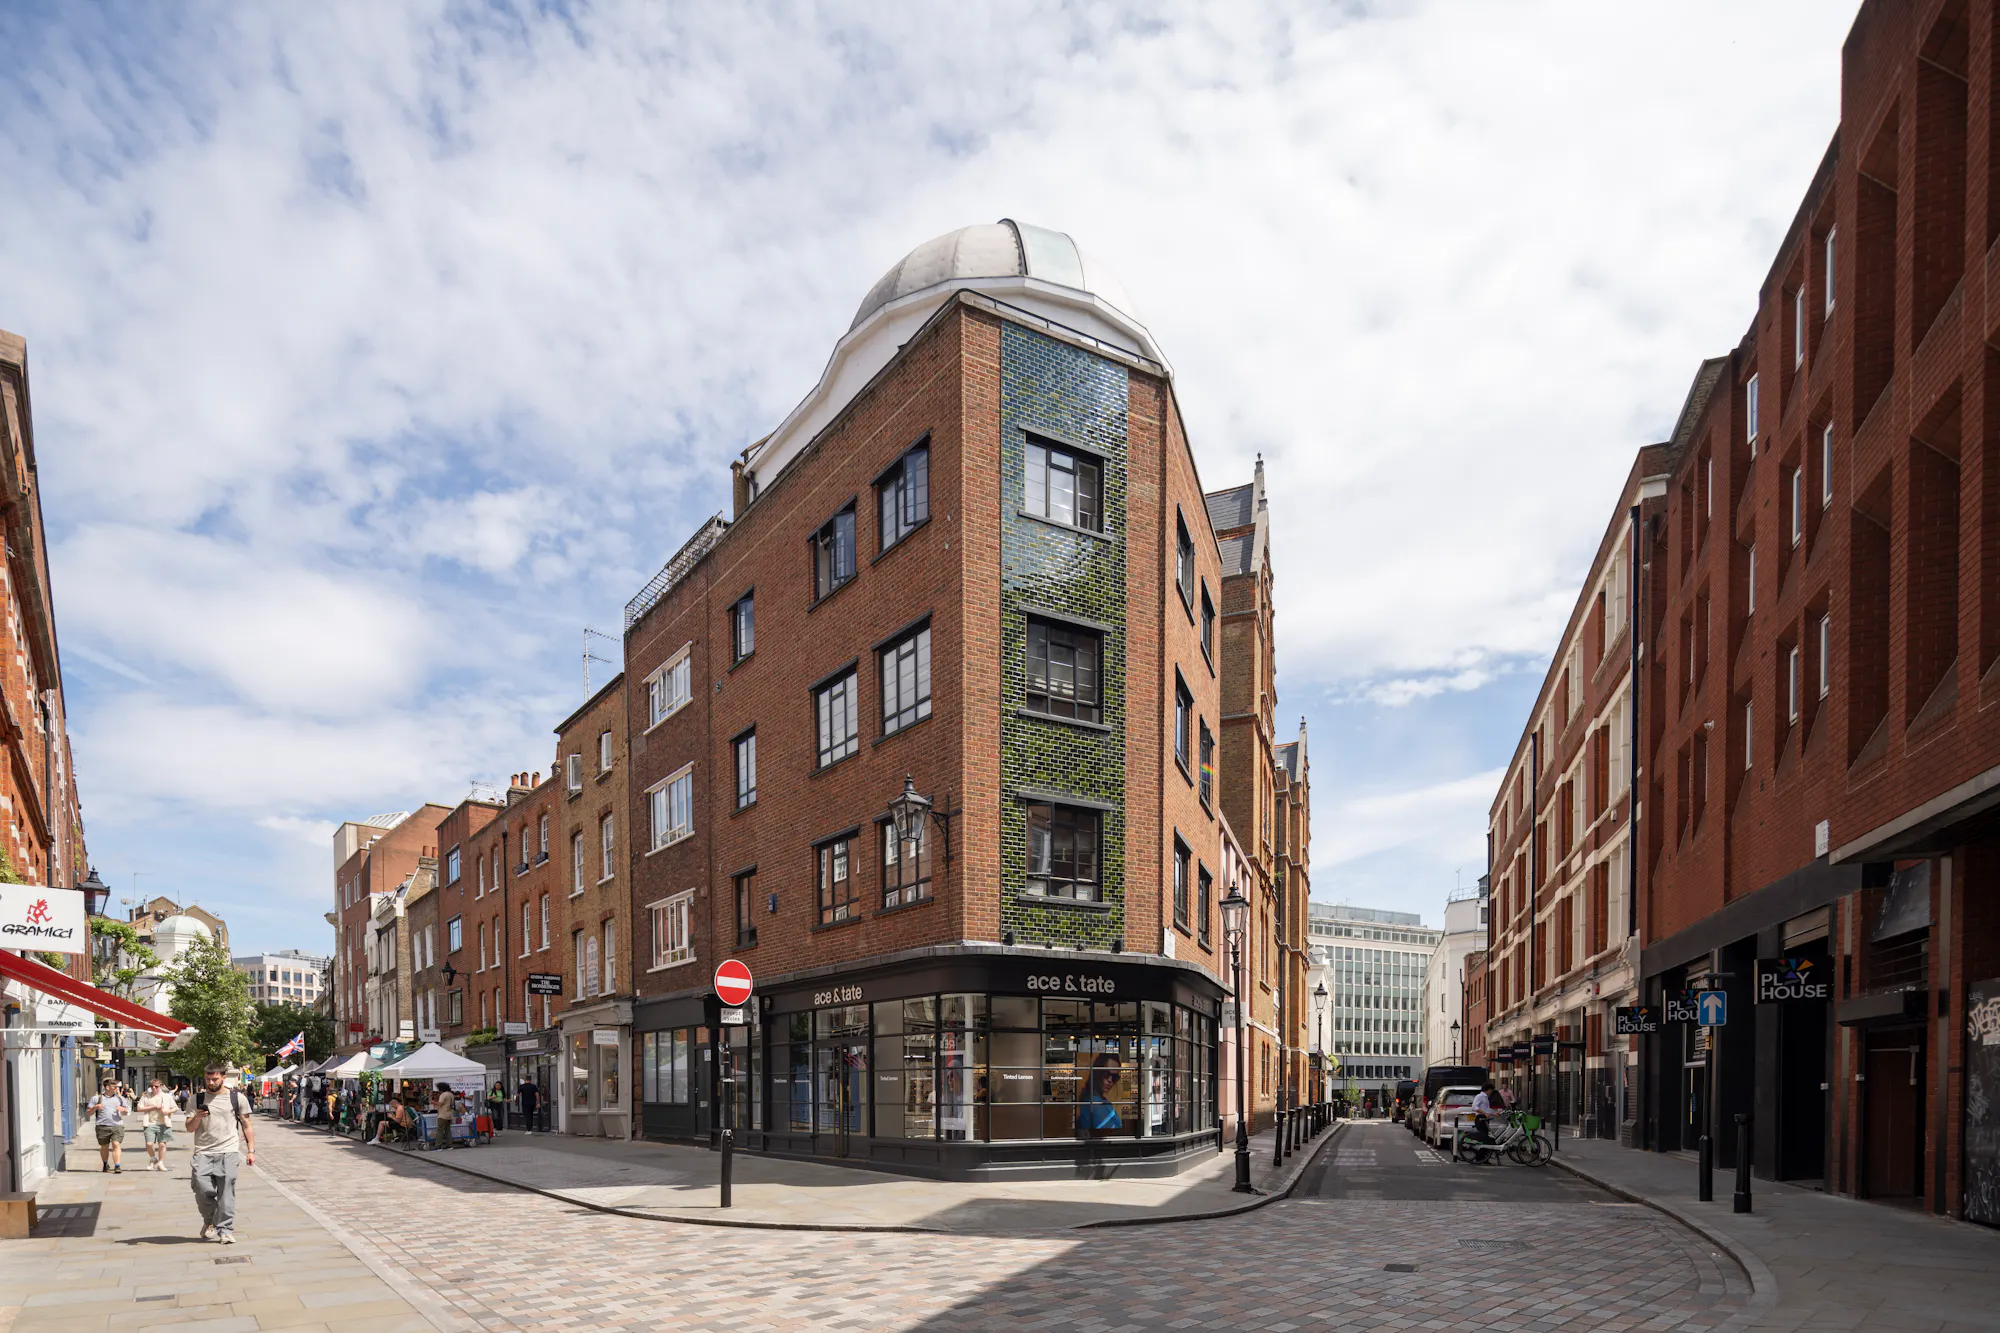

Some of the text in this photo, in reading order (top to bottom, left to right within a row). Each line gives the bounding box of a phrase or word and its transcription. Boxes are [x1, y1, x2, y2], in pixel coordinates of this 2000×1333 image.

[2, 924, 73, 939] GRAMICCI
[1027, 974, 1115, 994] ace & tate
[1761, 984, 1827, 999] HOUSE
[814, 984, 863, 1006] ace & tate
[1667, 1010, 1699, 1021] HOU
[1617, 1023, 1656, 1033] HOUSE
